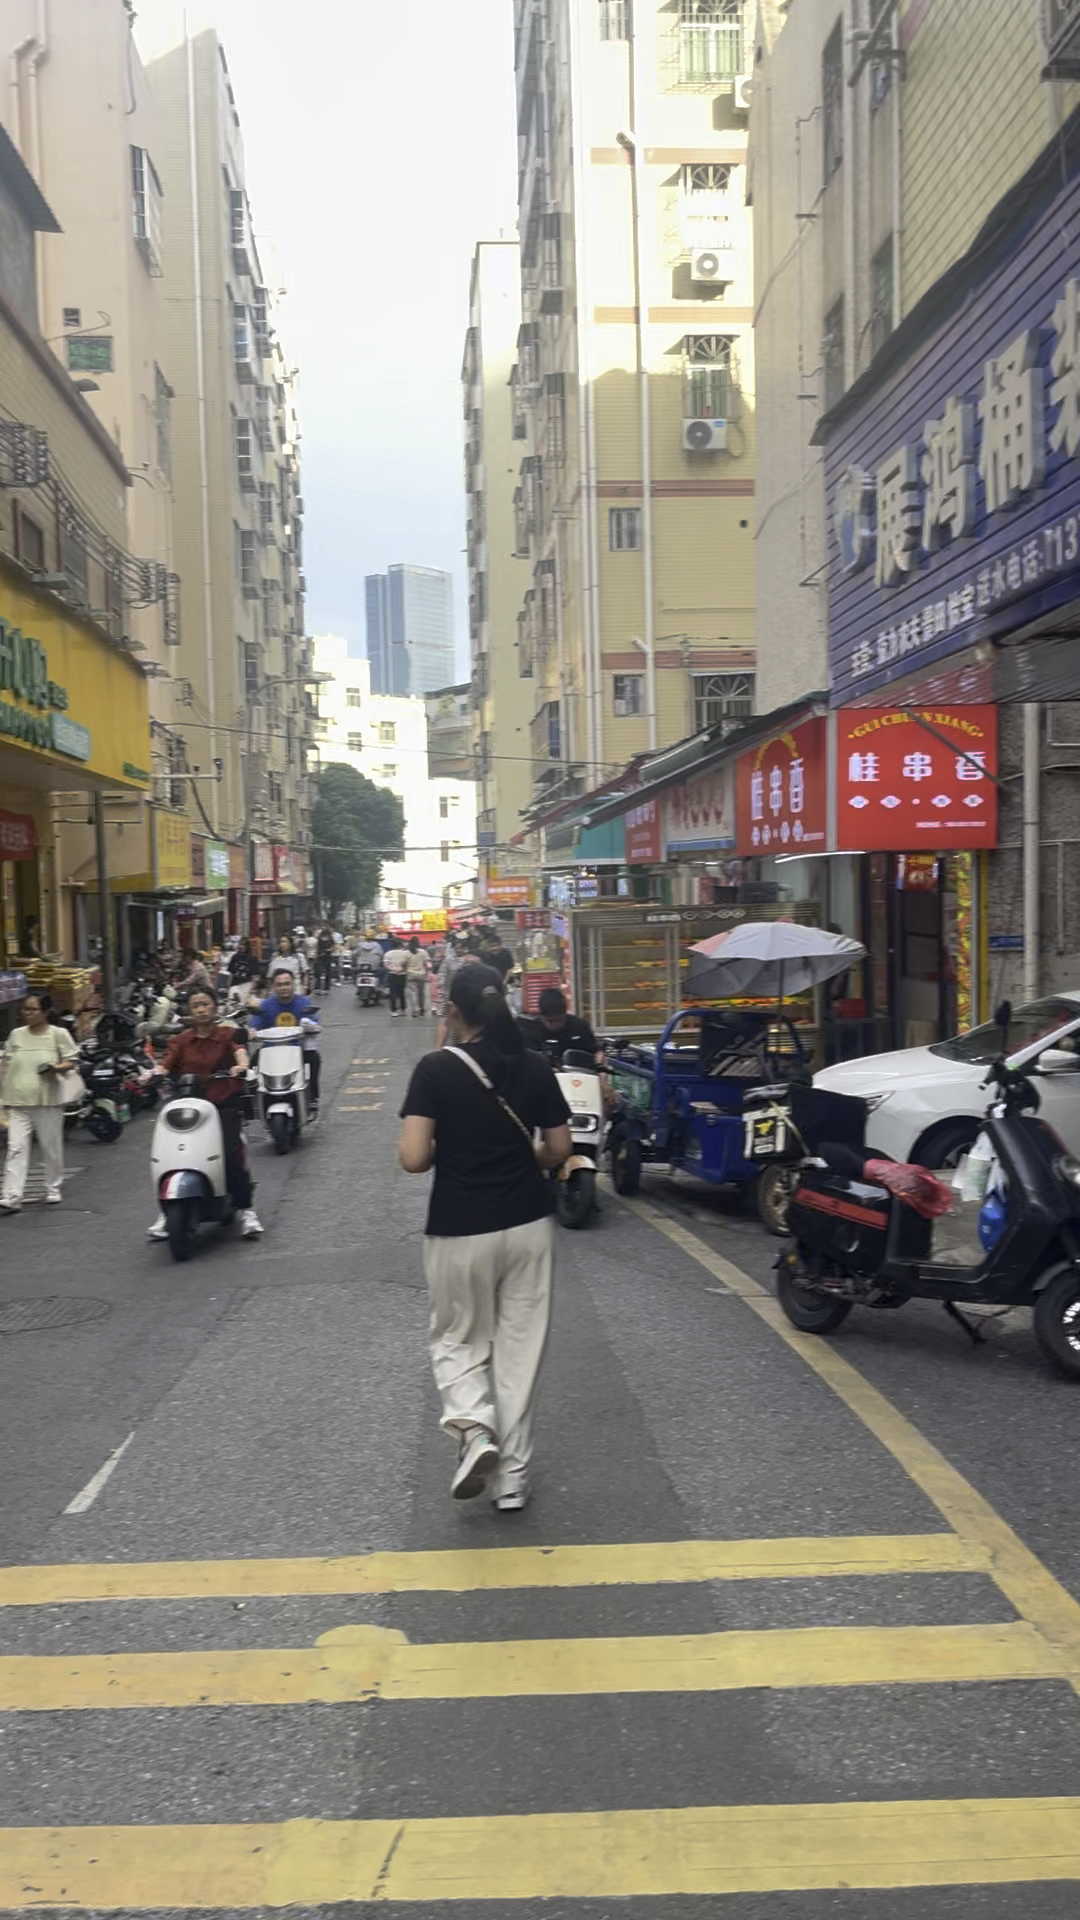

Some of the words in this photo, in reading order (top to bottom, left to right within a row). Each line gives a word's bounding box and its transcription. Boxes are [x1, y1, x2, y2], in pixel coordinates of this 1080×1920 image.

[853, 719, 881, 737] GUI
[881, 712, 933, 725] CHUN
[849, 752, 987, 782] 桂串香
